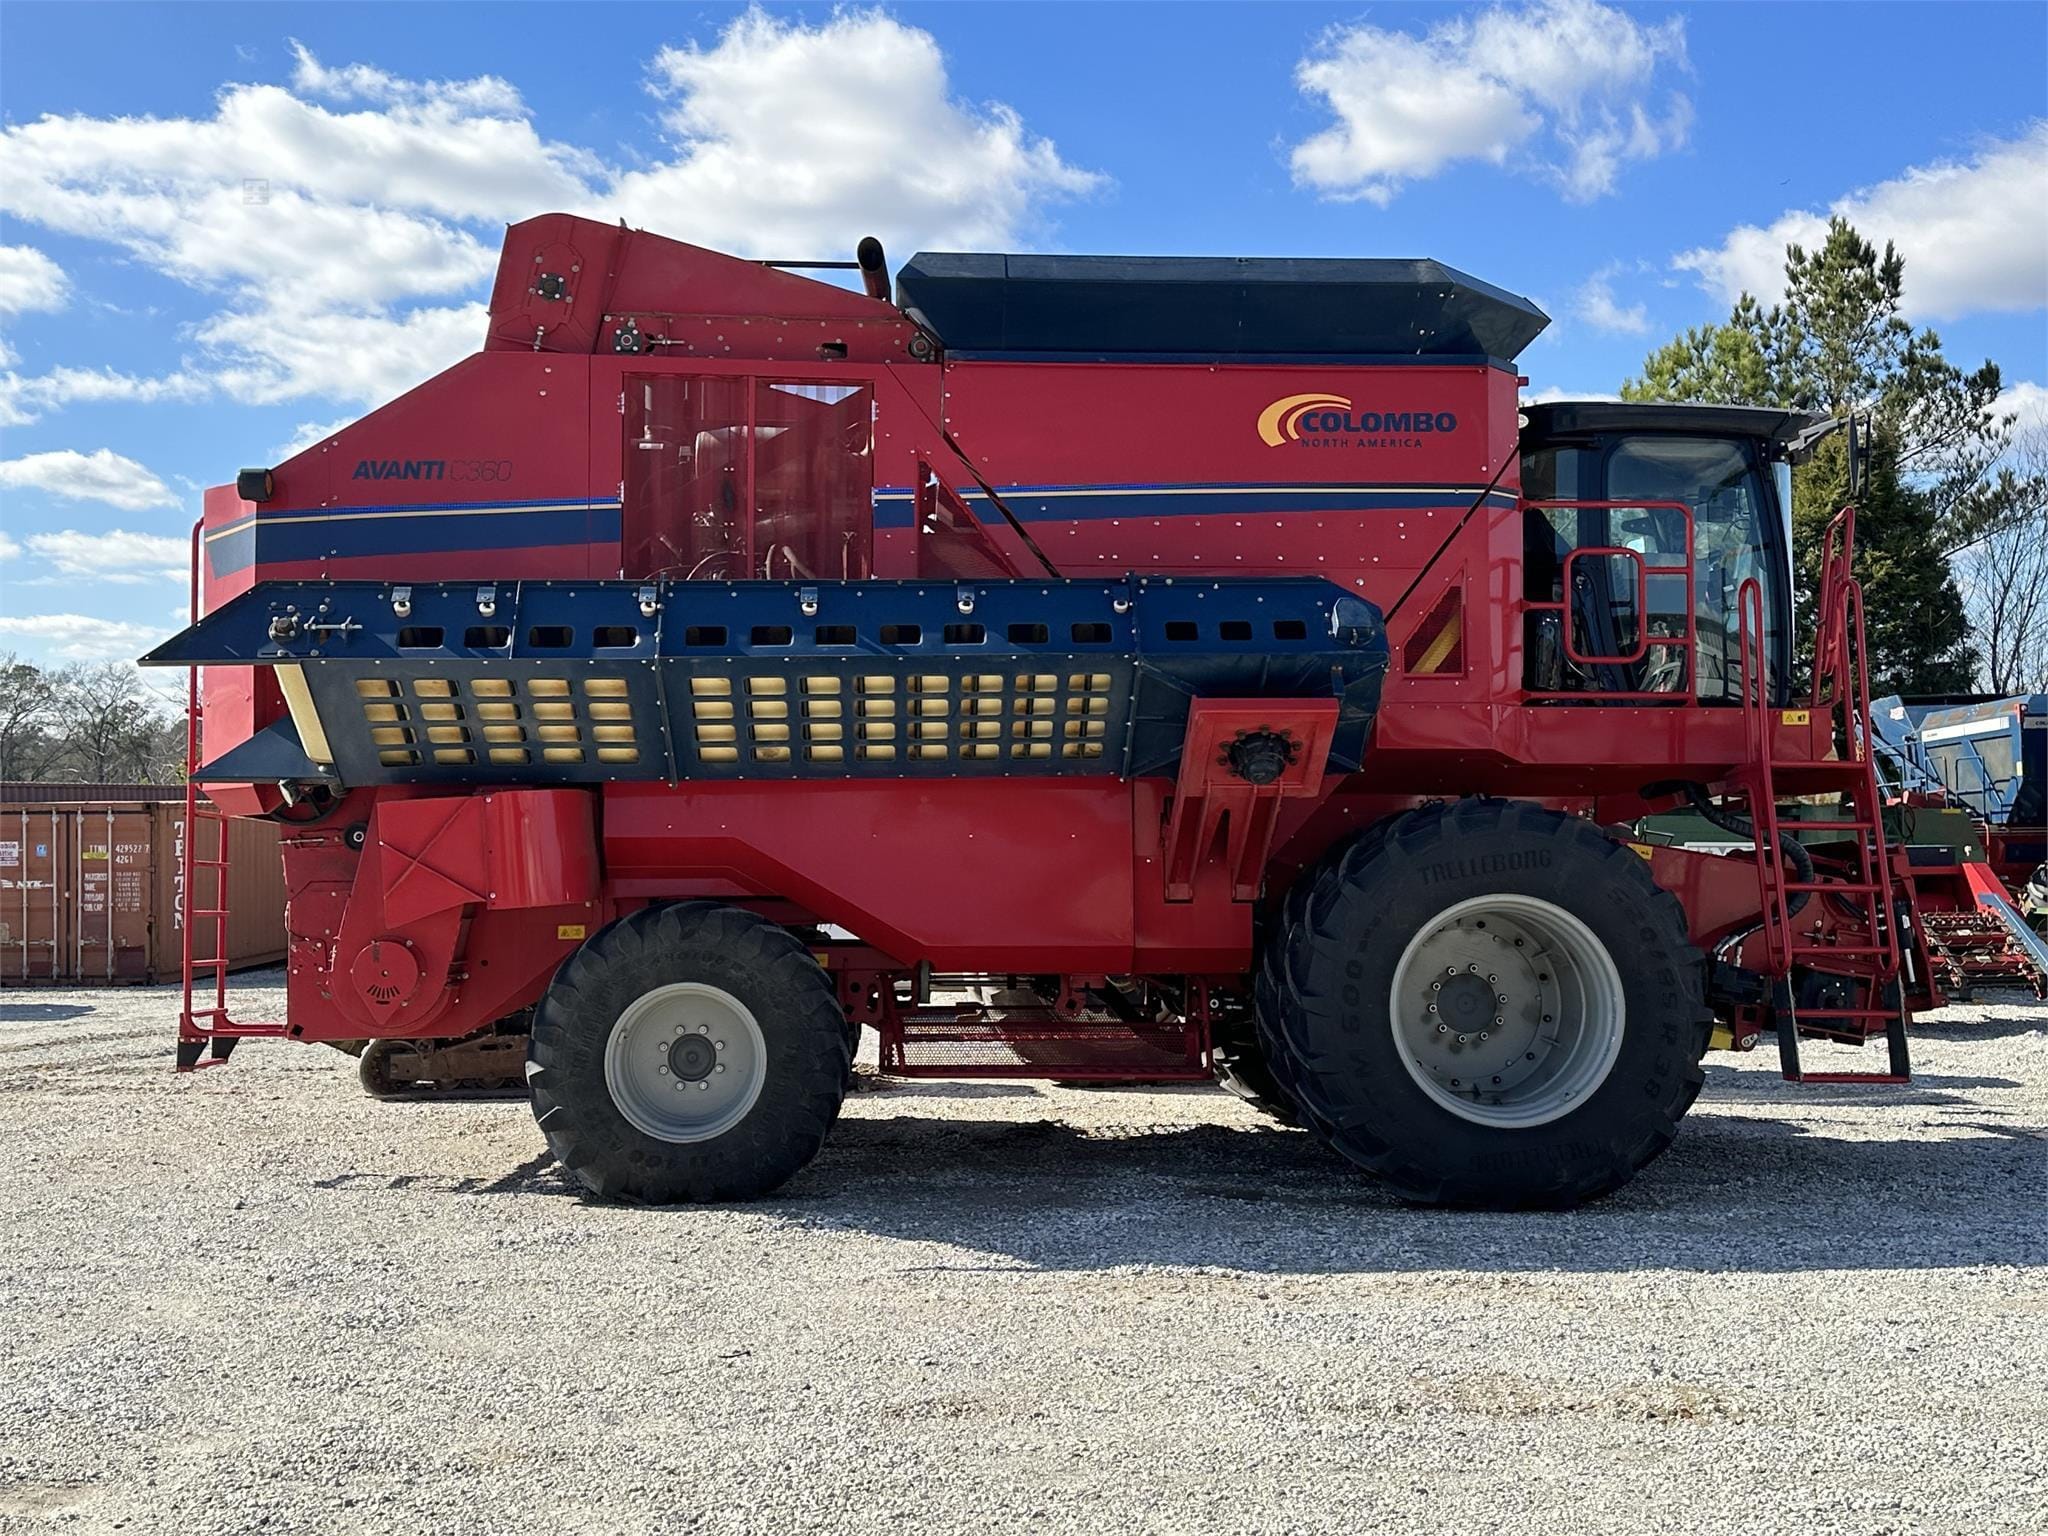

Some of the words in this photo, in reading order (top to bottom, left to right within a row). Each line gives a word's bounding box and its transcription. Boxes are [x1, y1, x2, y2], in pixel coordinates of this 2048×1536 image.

[1301, 412, 1458, 433] COLOMBO
[1301, 438, 1349, 448] NORTH
[1357, 438, 1423, 448] AMERICA
[351, 459, 446, 480] AVANTI
[450, 459, 514, 482] C360
[1418, 847, 1553, 885] TRELLEBORG
